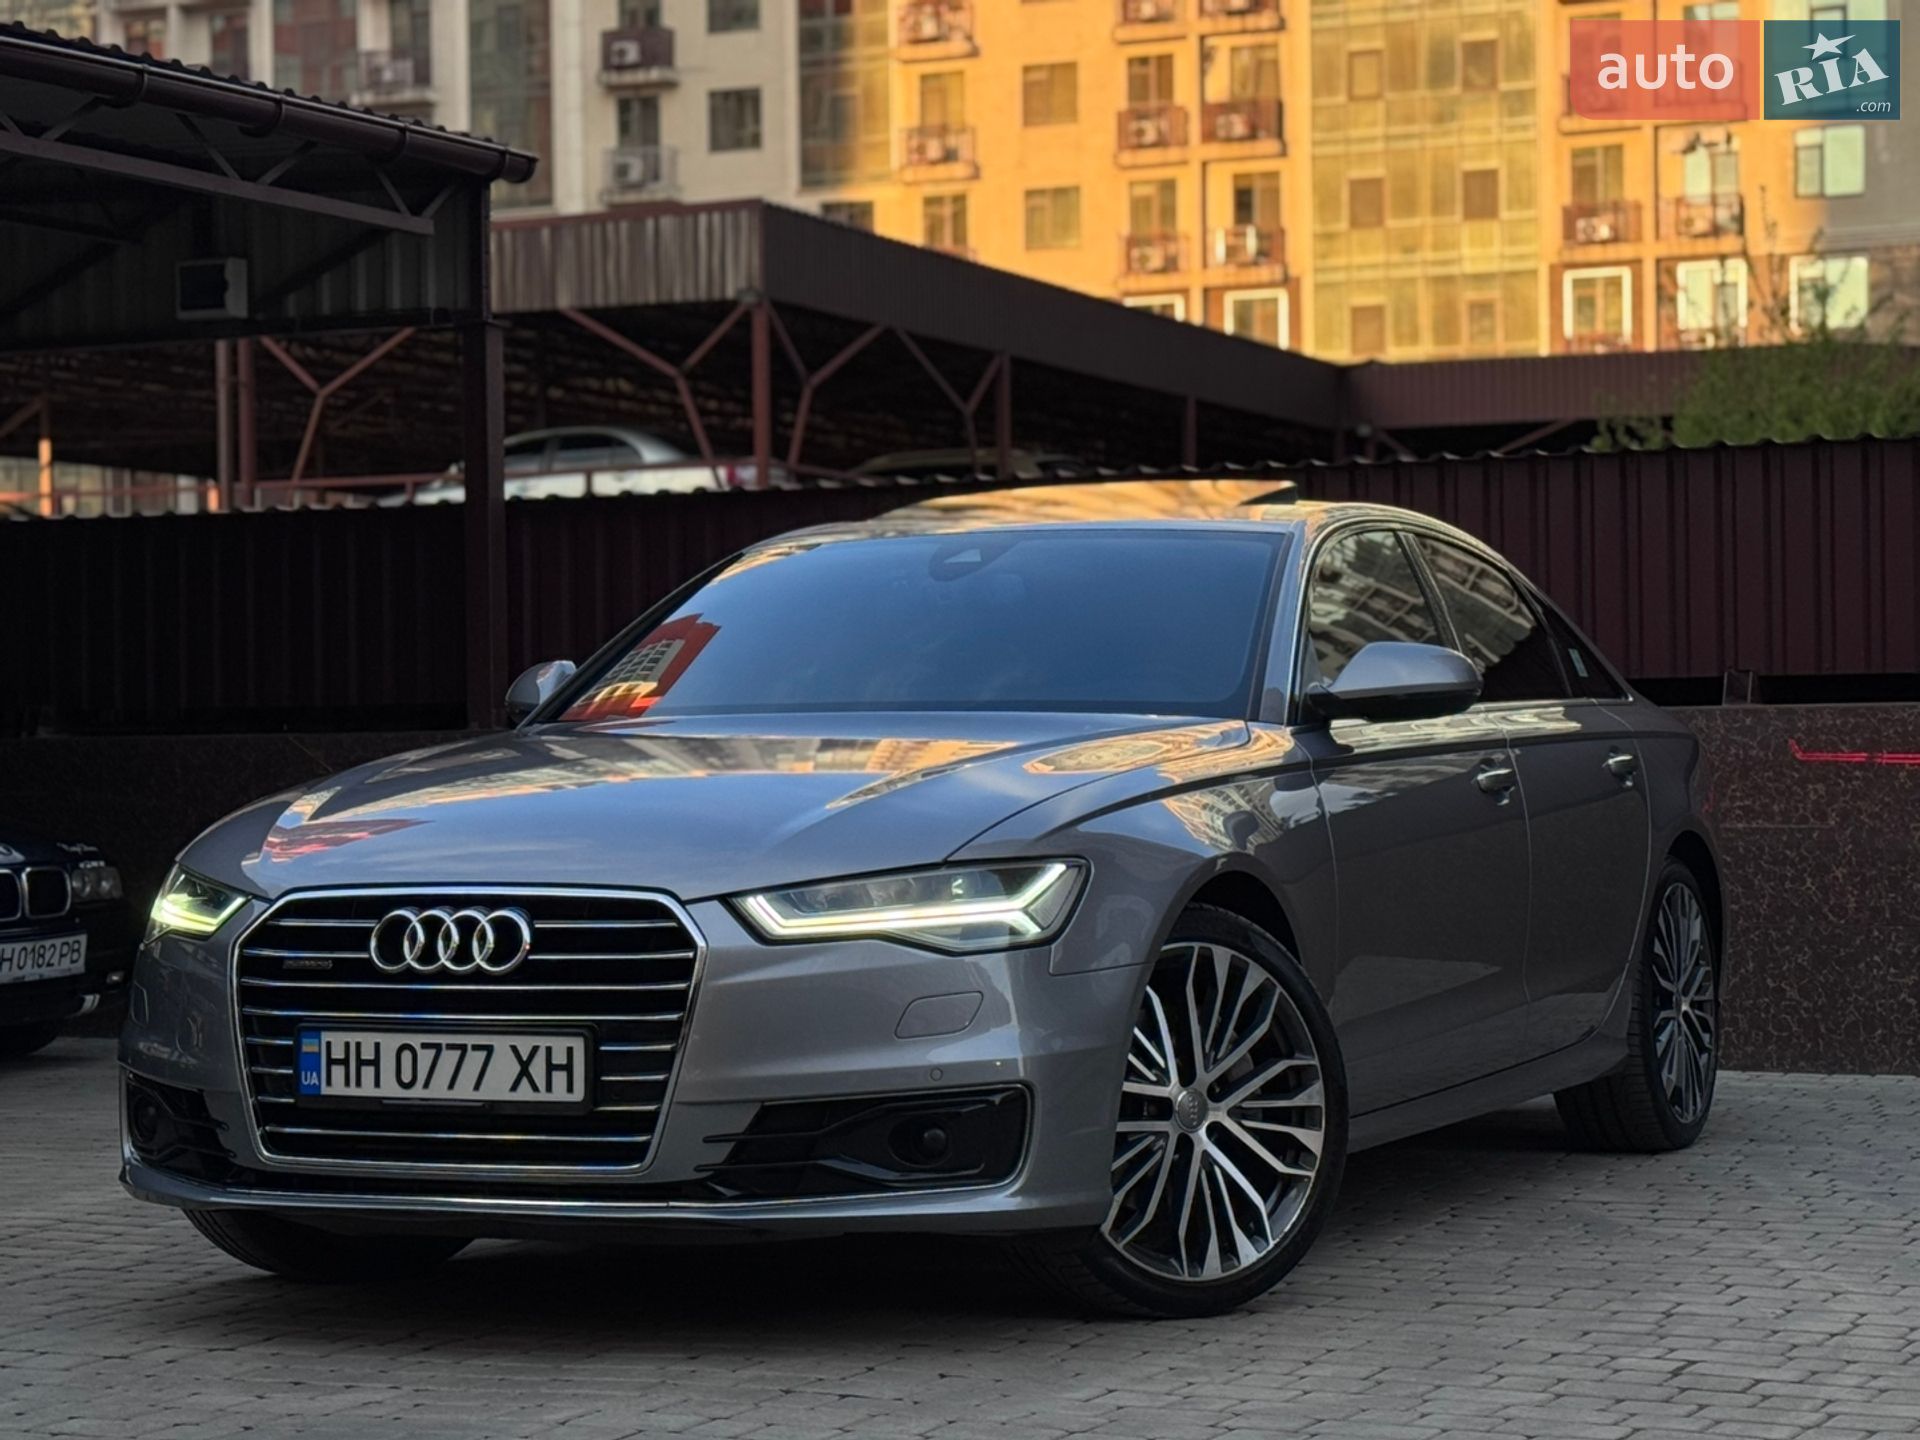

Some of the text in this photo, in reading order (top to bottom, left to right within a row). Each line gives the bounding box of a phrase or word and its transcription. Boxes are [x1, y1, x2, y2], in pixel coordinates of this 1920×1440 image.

[301, 1070, 319, 1086] UA
[325, 1040, 575, 1094] HH 0777 XH
